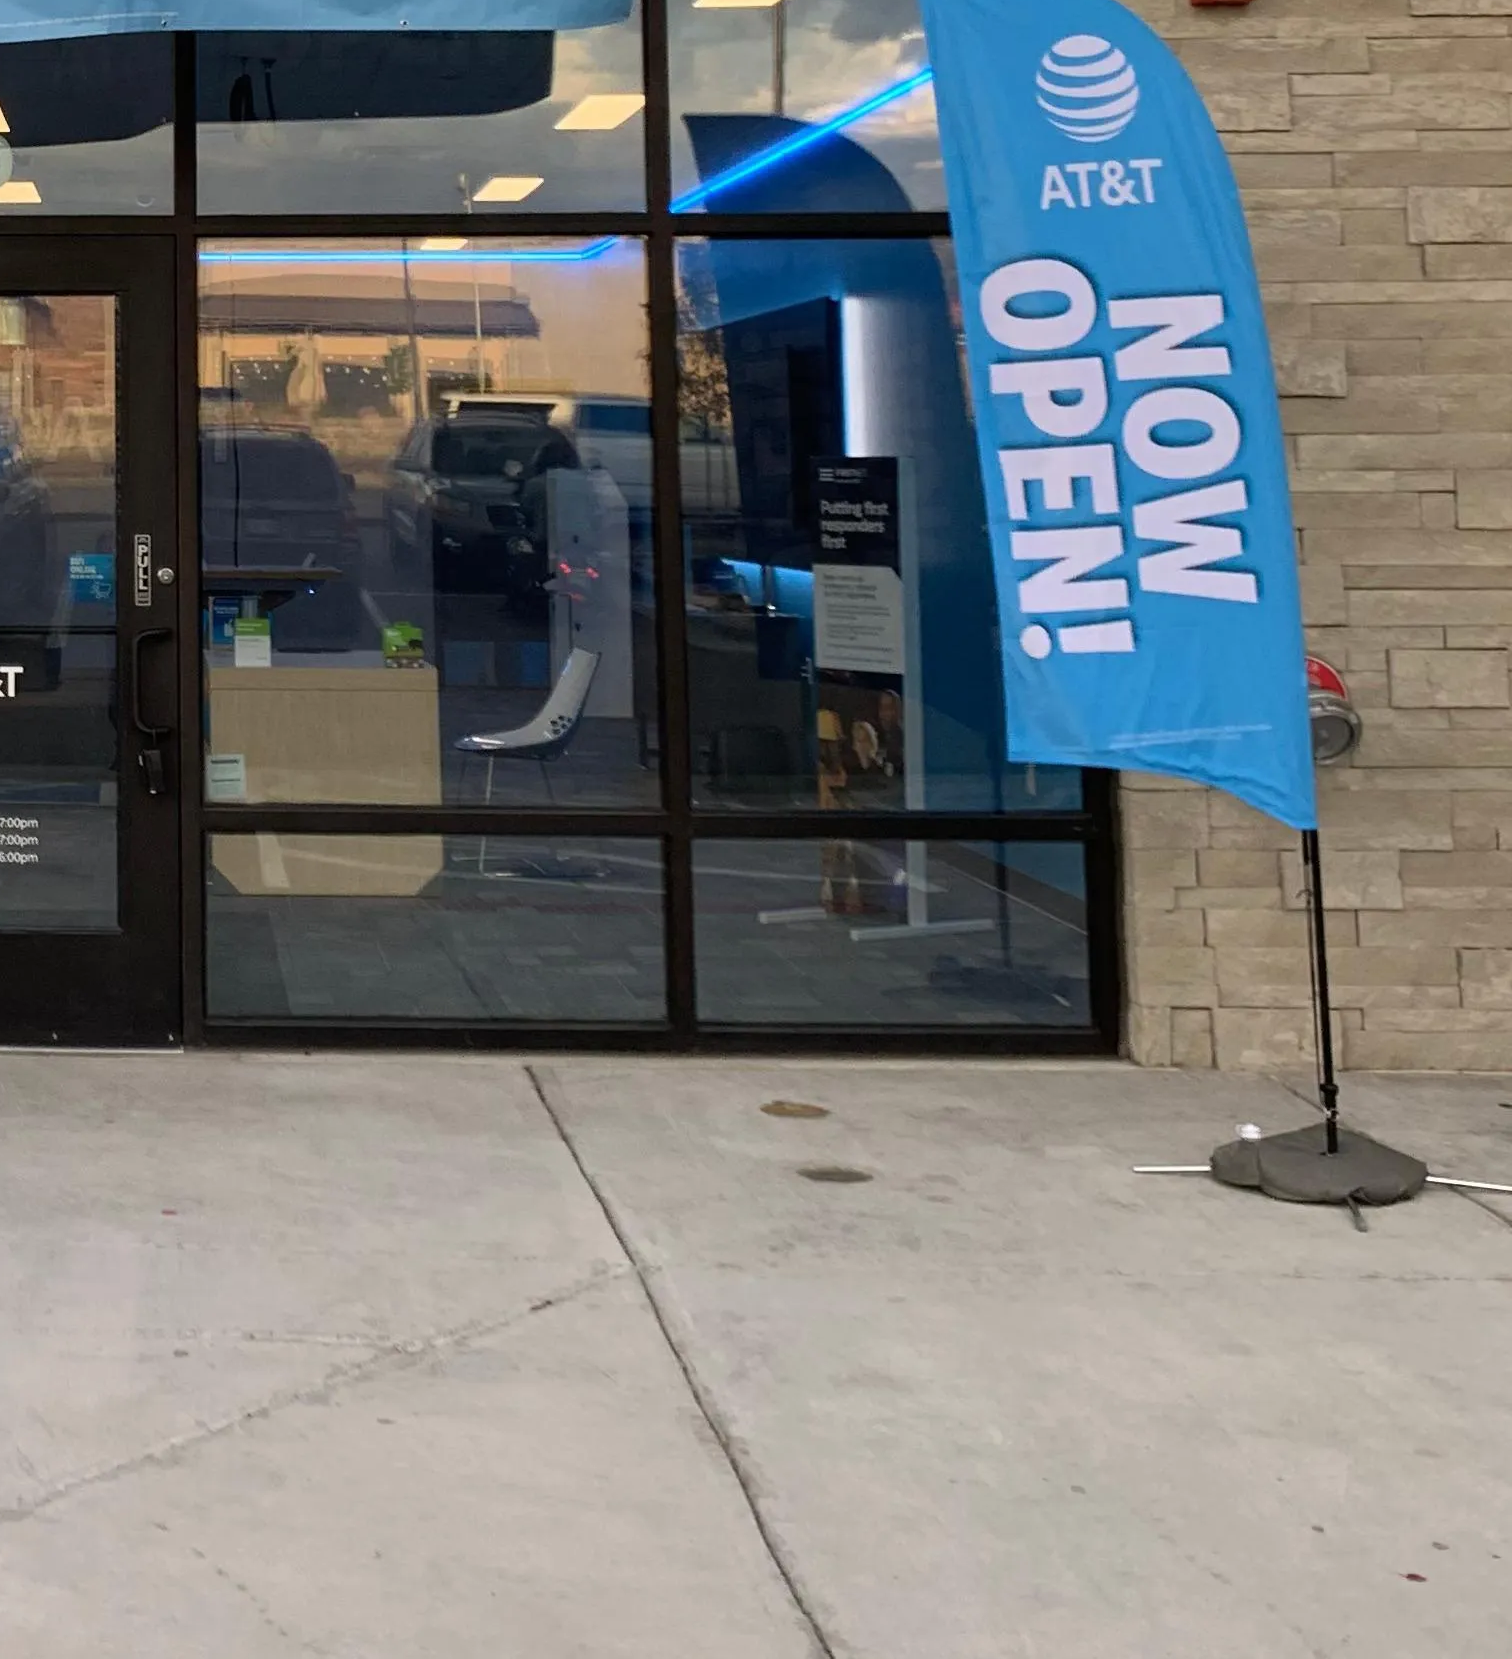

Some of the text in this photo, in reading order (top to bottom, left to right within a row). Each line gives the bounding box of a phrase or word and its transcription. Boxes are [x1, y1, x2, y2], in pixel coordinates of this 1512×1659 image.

[1039, 158, 1163, 211] AT&T
[978, 257, 1136, 661] OPEN!
[1107, 293, 1259, 604] NOW
[820, 500, 863, 518] Putting
[820, 519, 886, 534] responders
[137, 544, 149, 590] PULL
[0, 816, 39, 830] 7:00pm
[0, 833, 39, 847] 7:00pm
